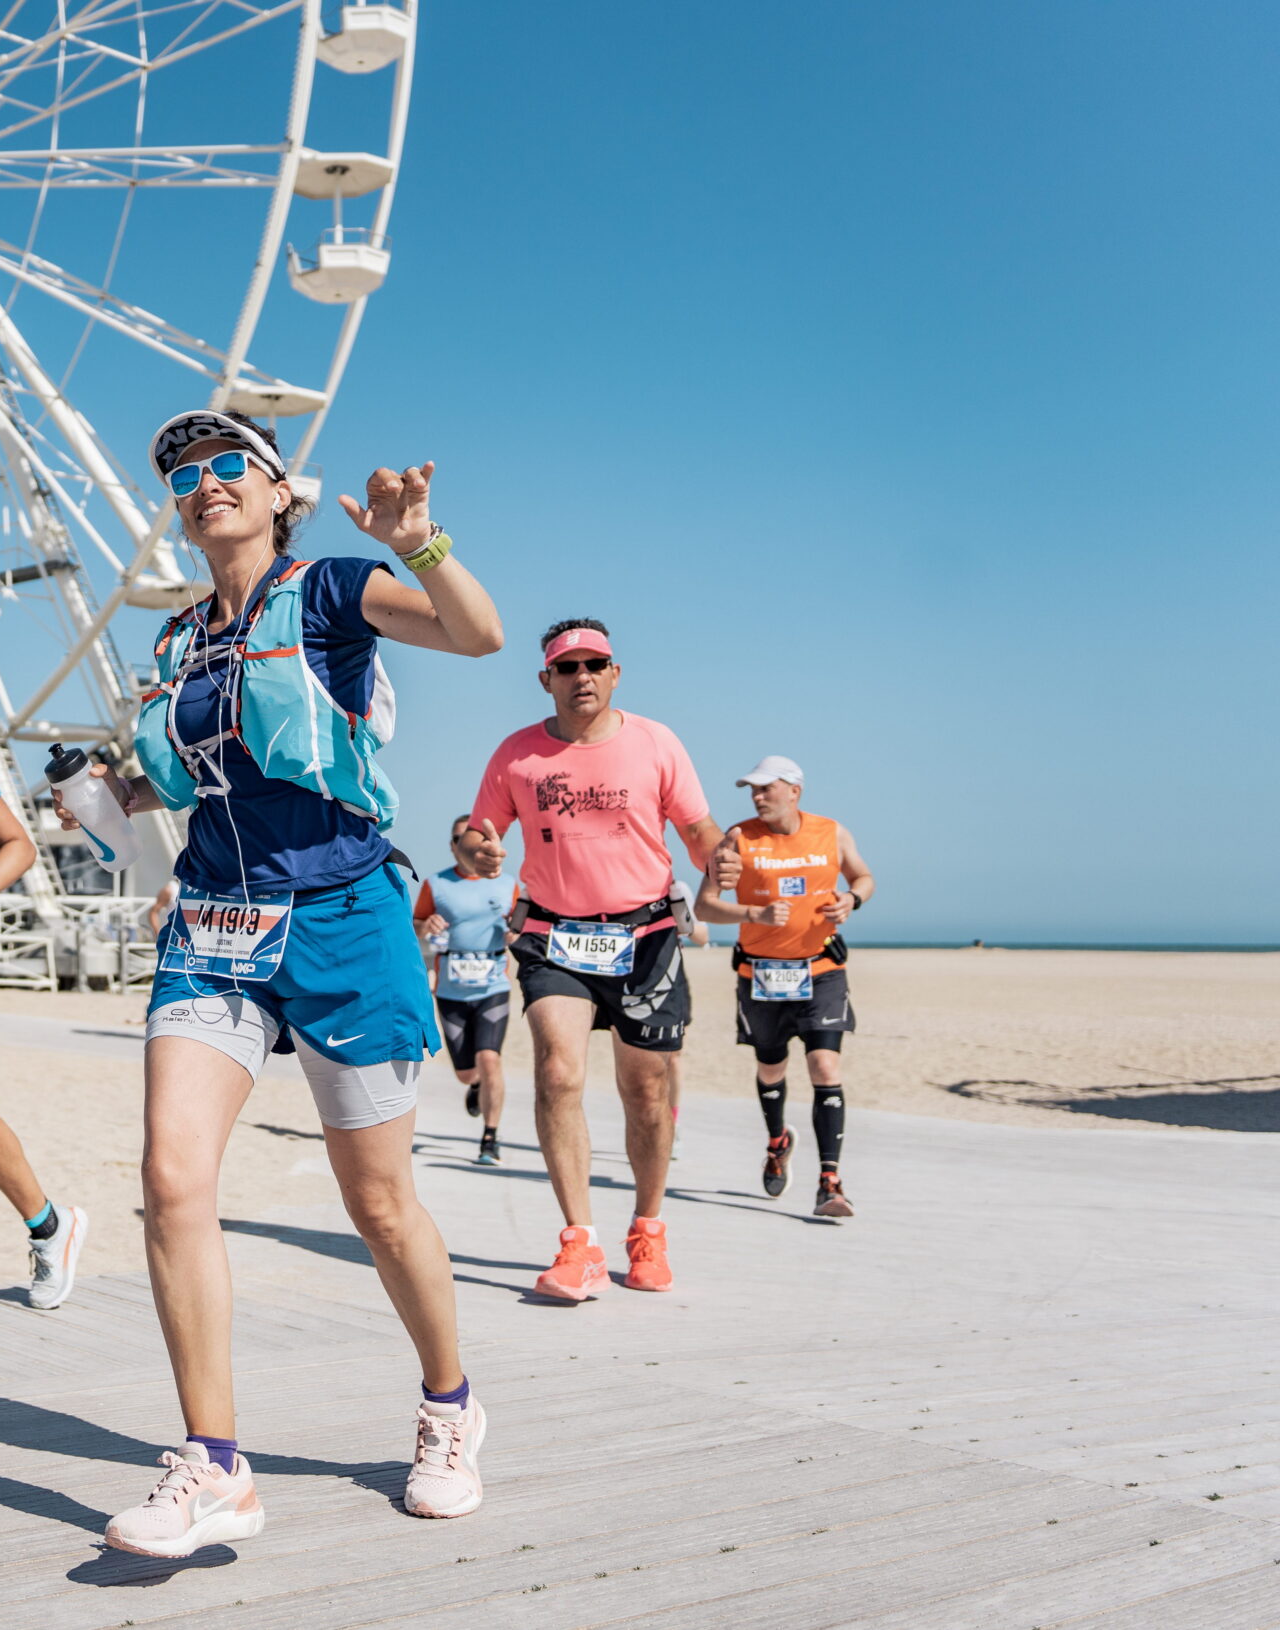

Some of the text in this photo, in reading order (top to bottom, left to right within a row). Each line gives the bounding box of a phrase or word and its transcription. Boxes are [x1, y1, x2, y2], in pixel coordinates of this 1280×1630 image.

[197, 904, 261, 936] M 1919
[568, 936, 617, 953] M 1554
[230, 962, 256, 974] NXP
[775, 970, 800, 982] 2105
